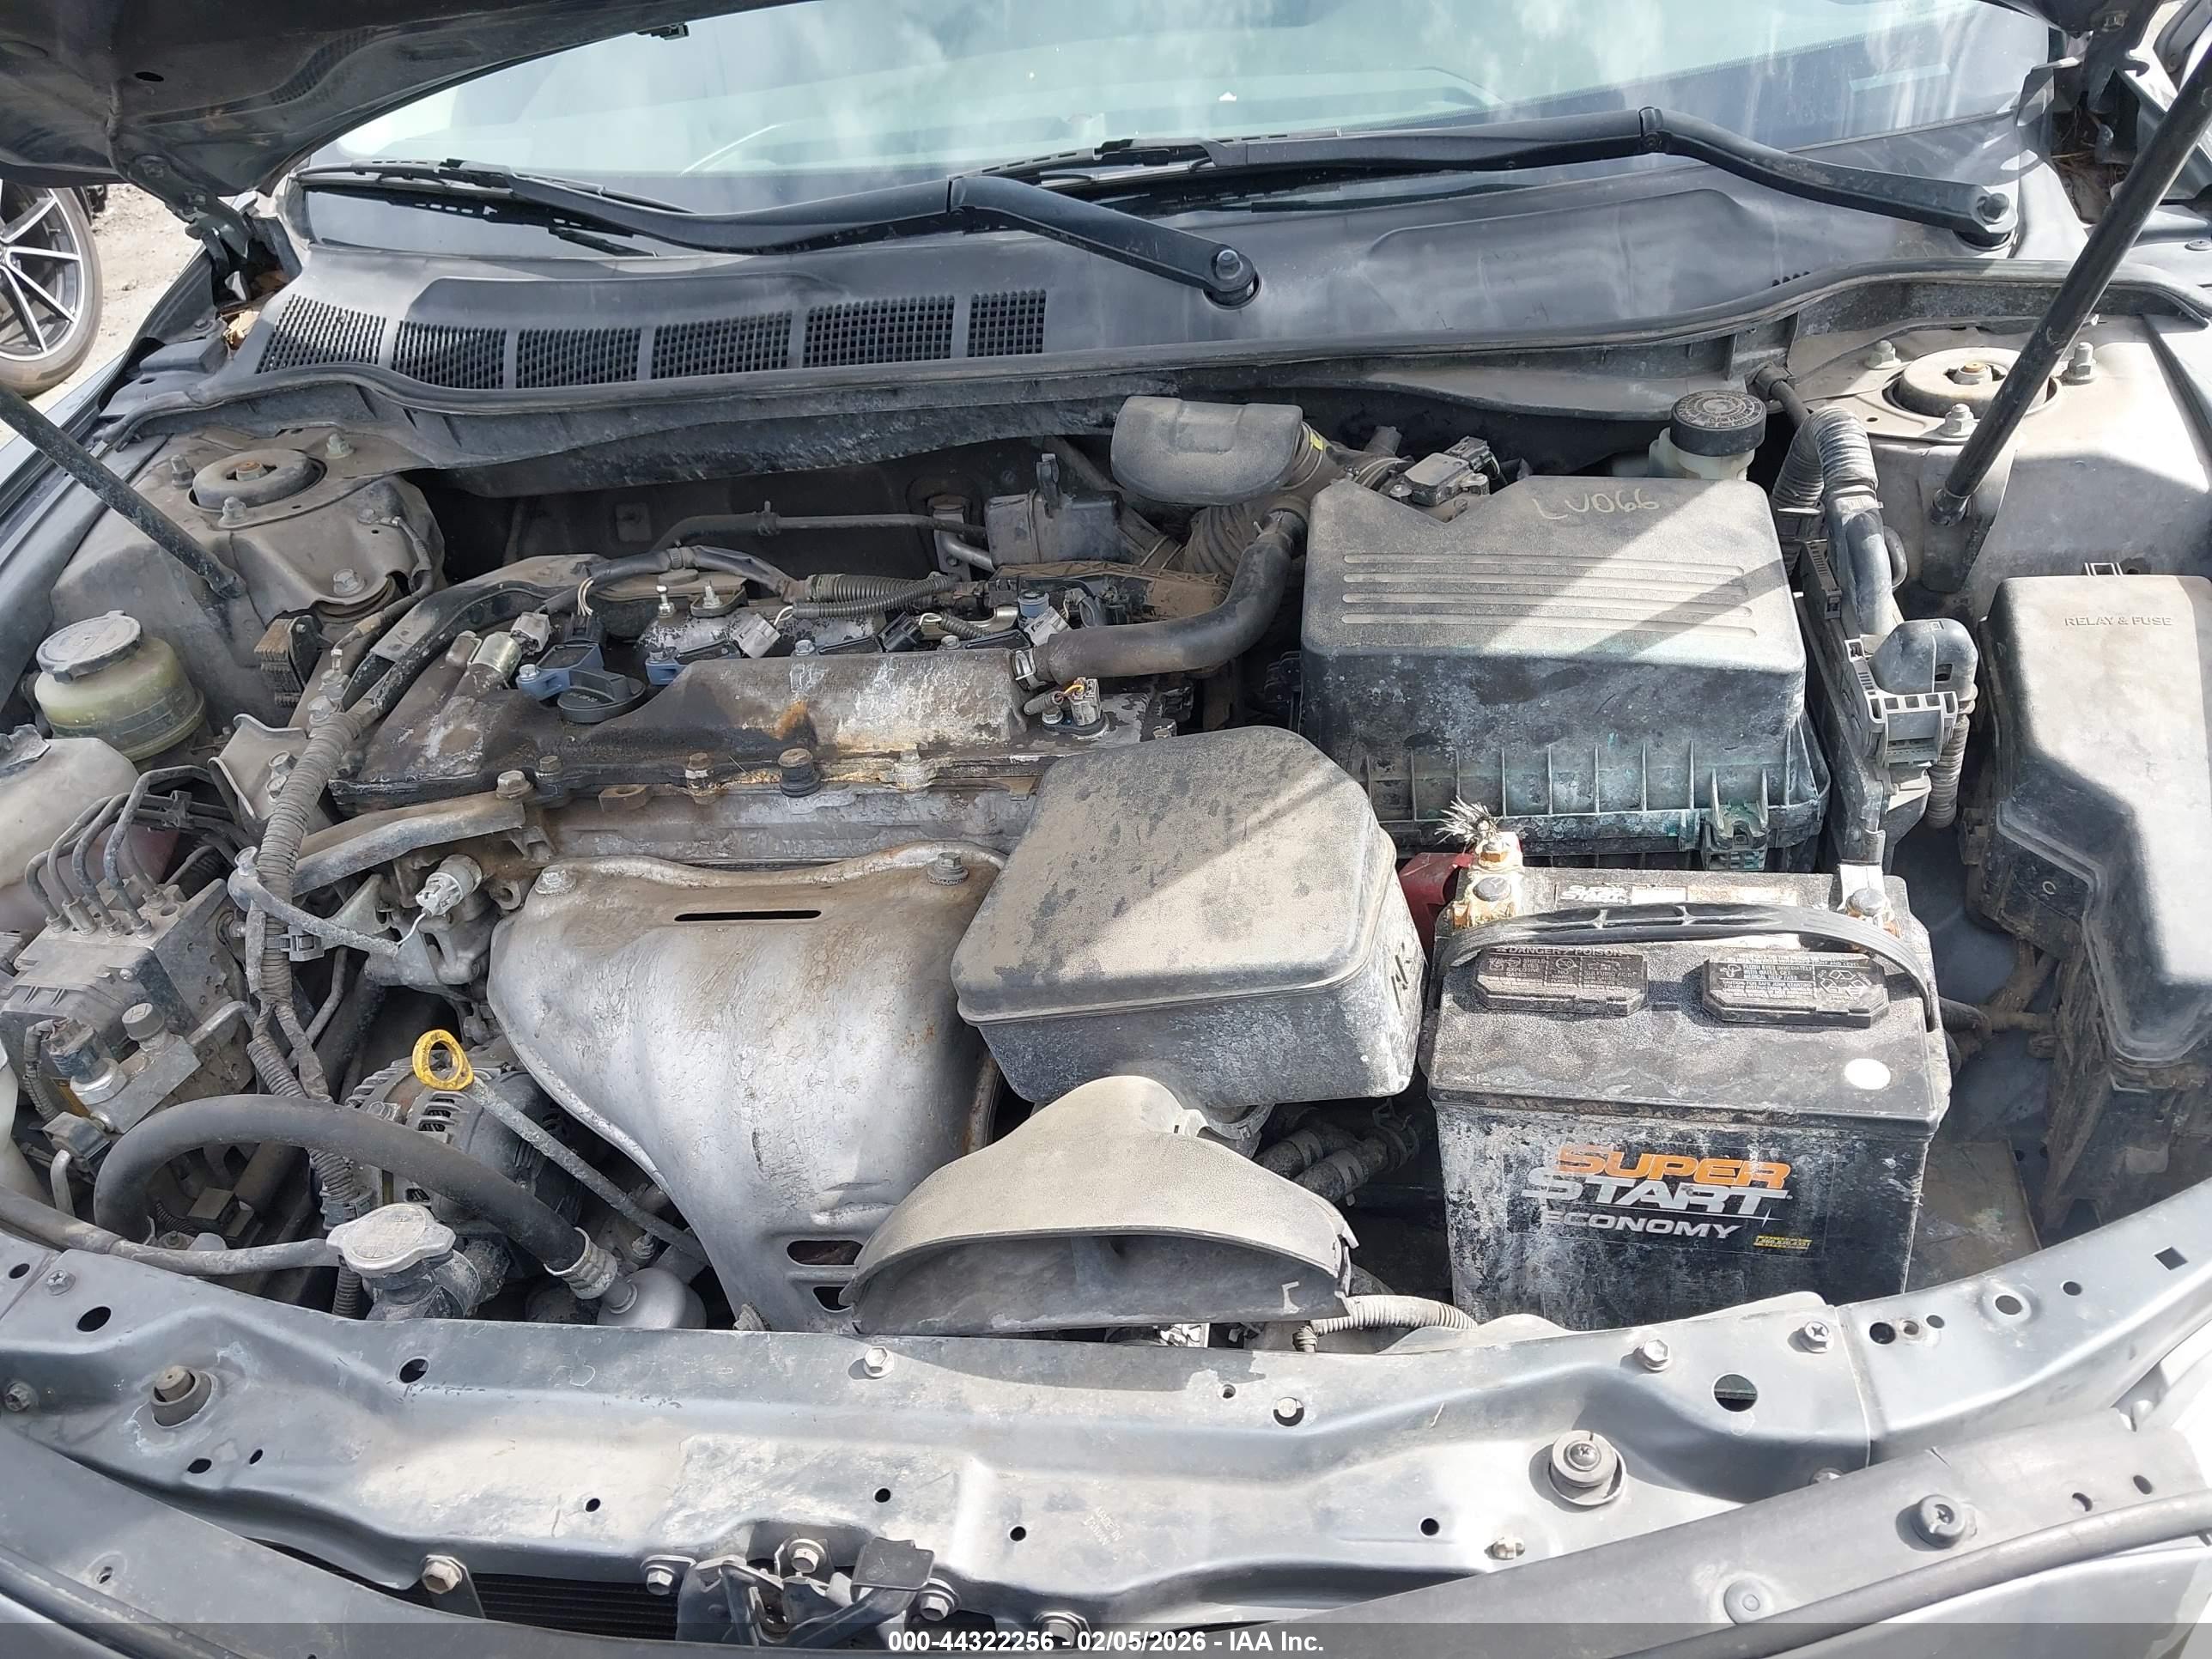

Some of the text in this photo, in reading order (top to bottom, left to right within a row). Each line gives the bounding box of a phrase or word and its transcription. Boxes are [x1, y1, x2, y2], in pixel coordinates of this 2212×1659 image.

[2064, 616, 2115, 627] RELAY
[2131, 616, 2173, 627] FUSE
[1509, 946, 1561, 956] DANGER
[1574, 948, 1622, 957] POISON
[1556, 1146, 1791, 1189] SUPER
[1522, 1167, 1790, 1216] START
[1543, 1210, 1743, 1239] ECONOMY
